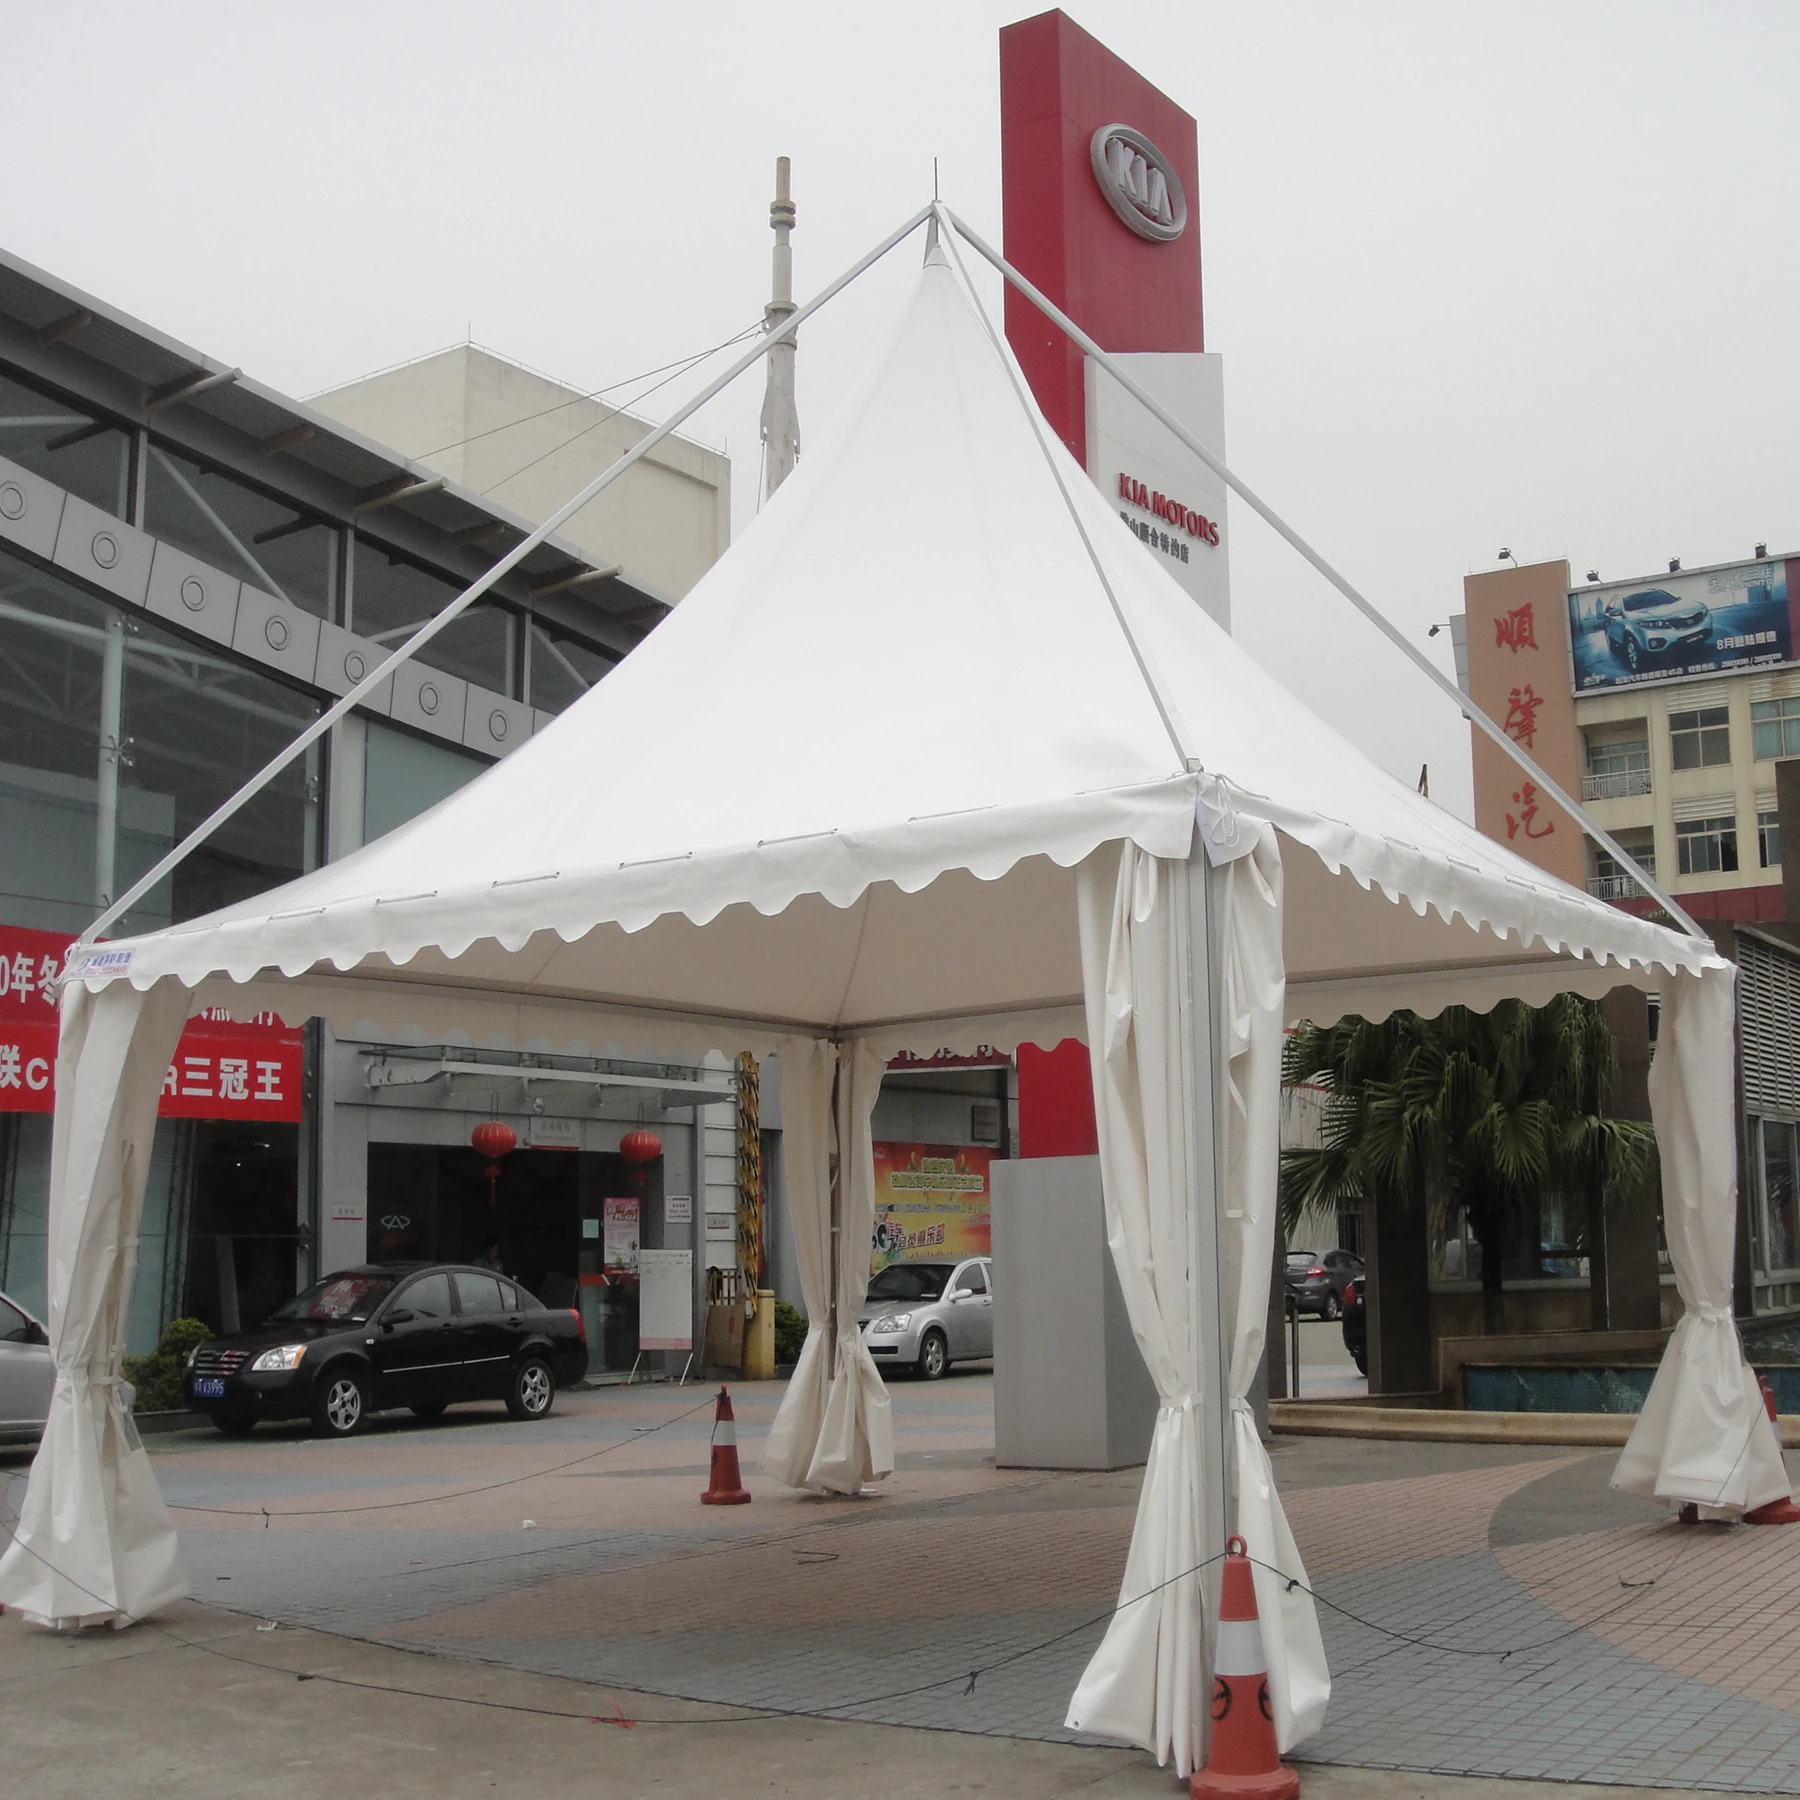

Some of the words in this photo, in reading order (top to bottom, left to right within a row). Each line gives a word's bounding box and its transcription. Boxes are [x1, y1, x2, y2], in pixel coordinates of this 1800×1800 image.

[1106, 137, 1173, 225] KIA
[1118, 473, 1150, 511] KIA
[1152, 491, 1220, 546] MOTORS
